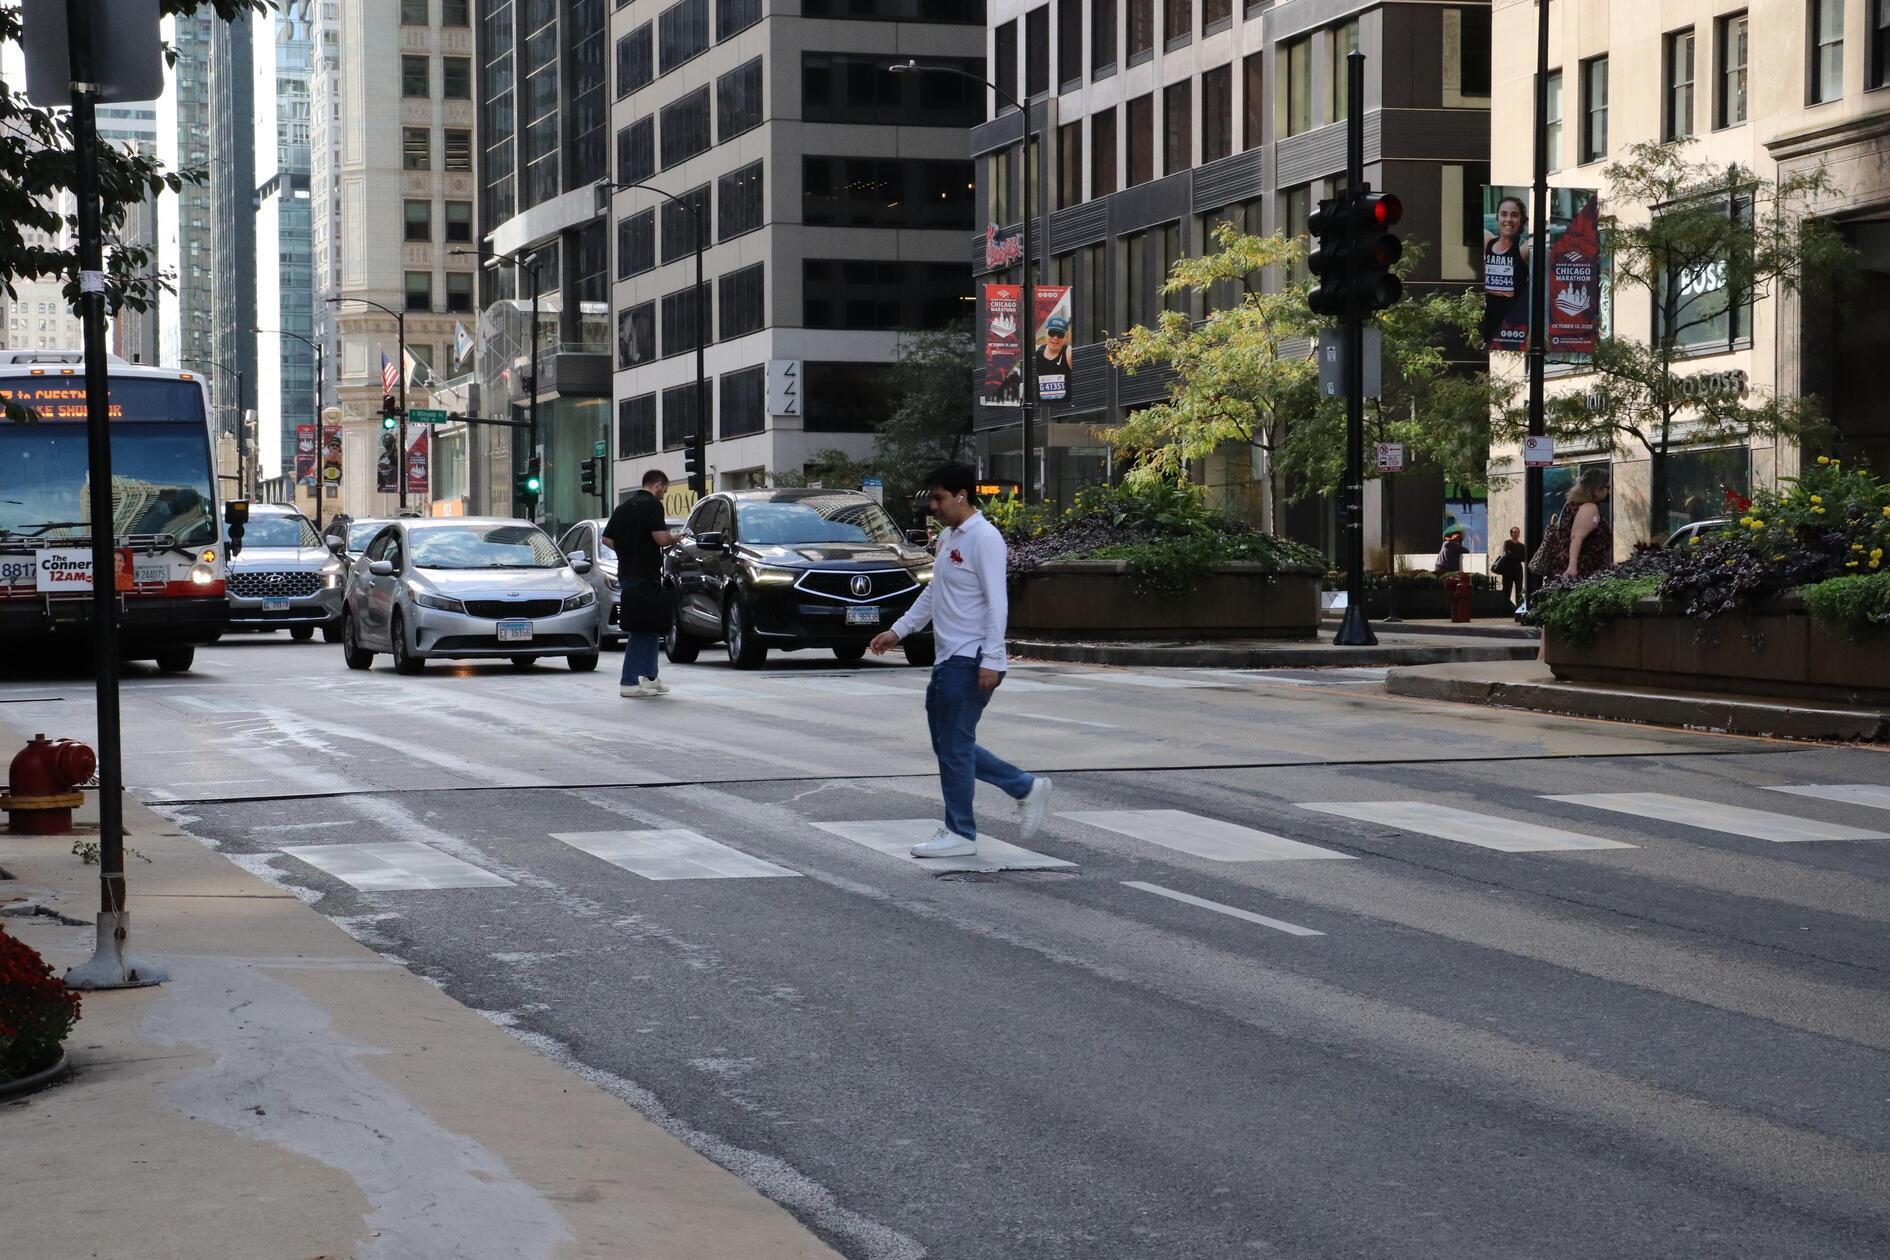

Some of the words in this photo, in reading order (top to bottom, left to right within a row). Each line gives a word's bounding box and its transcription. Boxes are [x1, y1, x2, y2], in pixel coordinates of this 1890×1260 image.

[1486, 255, 1513, 266] SARAH
[1556, 267, 1590, 275] CHICAGO
[1491, 276, 1513, 286] 56544
[1045, 382, 1065, 391] 41351
[42, 560, 93, 570] Conner
[50, 571, 86, 581] 12AM
